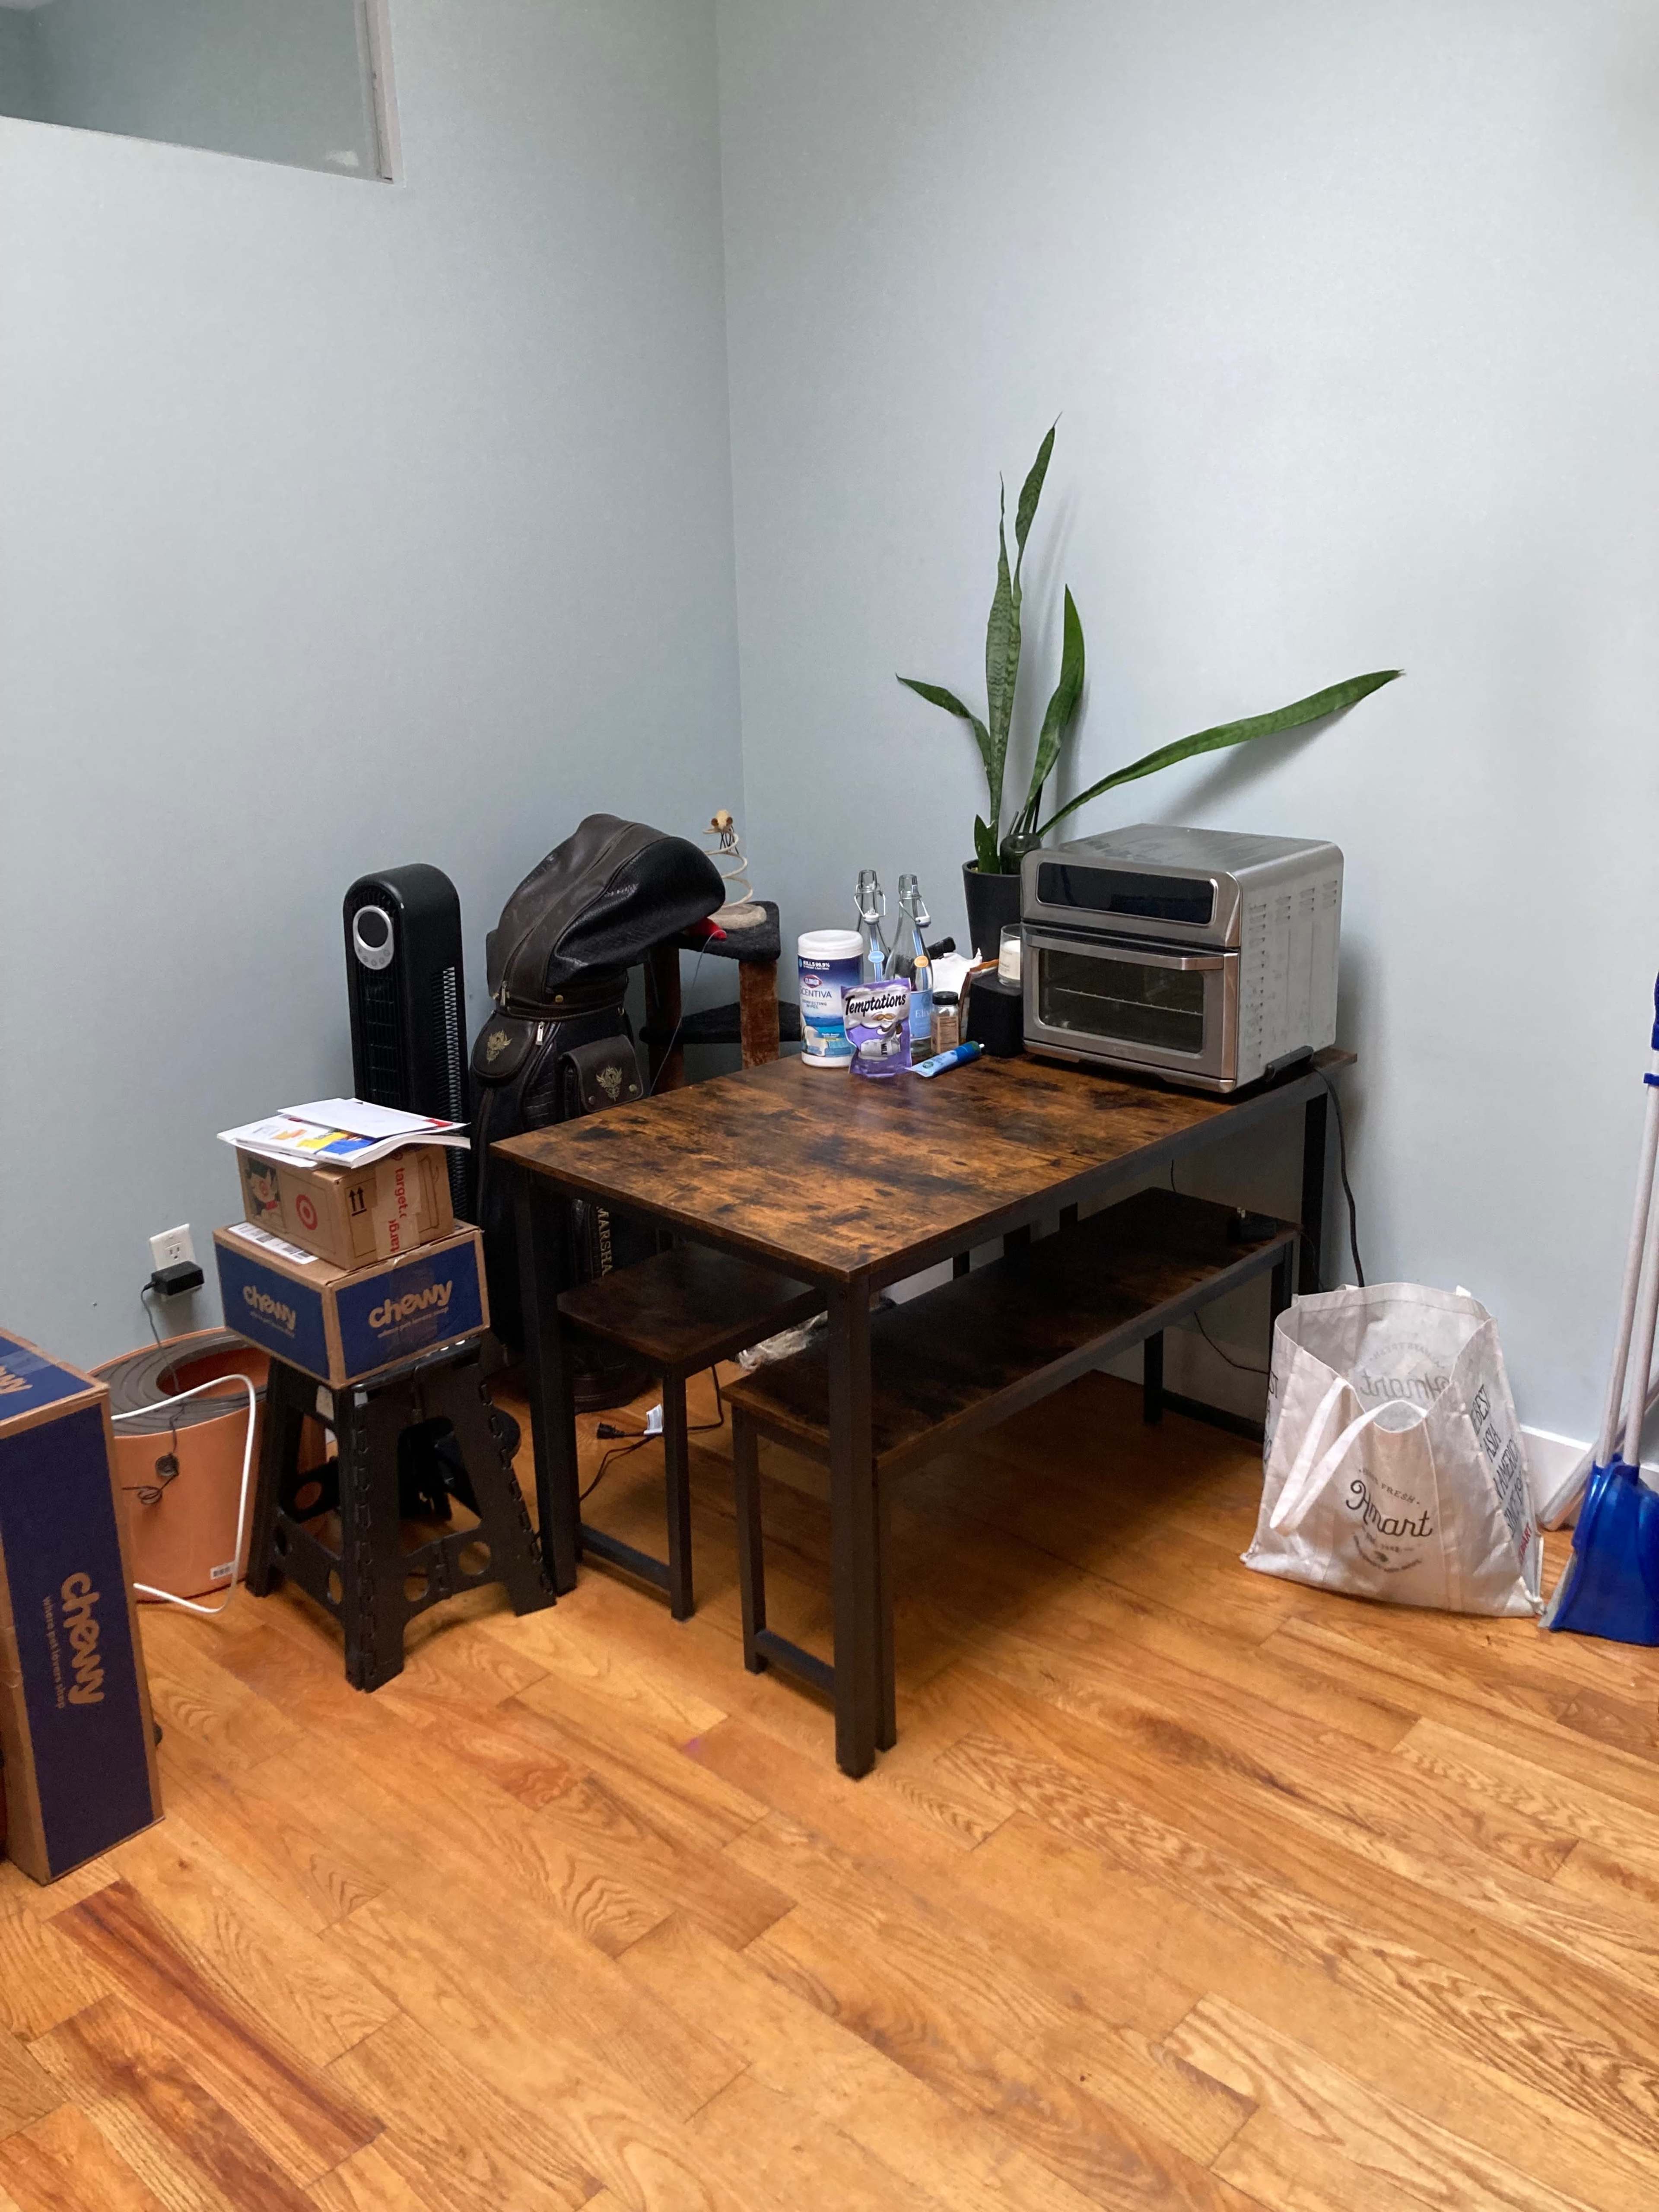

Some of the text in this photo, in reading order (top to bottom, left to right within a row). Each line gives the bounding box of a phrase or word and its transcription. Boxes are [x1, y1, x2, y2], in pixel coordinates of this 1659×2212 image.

[845, 994, 906, 1017] Temptations
[242, 1285, 296, 1330] chewy
[369, 1280, 453, 1328] chewy
[1483, 1423, 1501, 1463] ASIA
[1346, 1479, 1433, 1537] Hmart
[1381, 1482, 1415, 1504] FRESH
[60, 1572, 105, 1704] chewy
